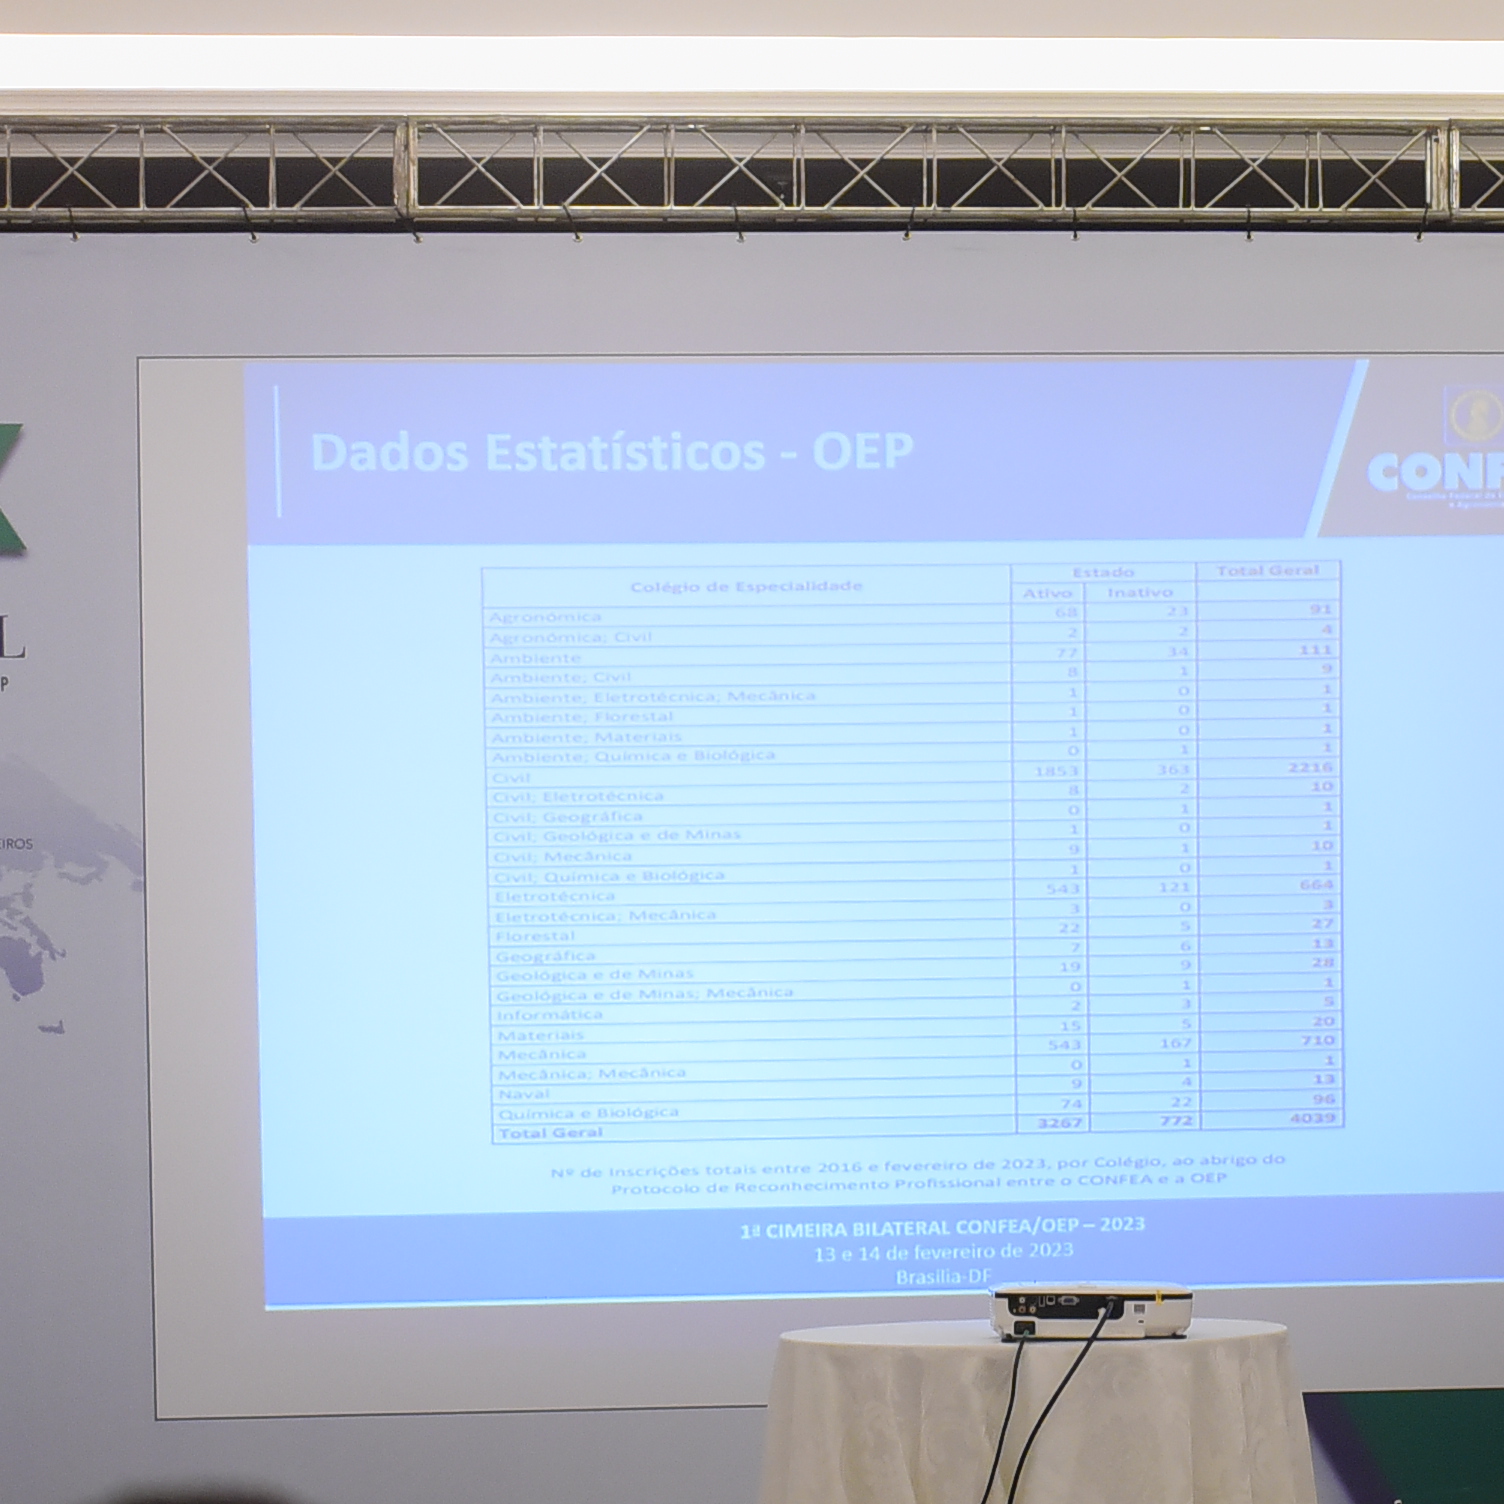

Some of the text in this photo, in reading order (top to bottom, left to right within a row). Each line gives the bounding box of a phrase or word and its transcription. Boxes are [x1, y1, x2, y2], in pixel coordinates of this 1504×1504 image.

[312, 431, 468, 472] Dados
[486, 431, 765, 472] Estatísticos
[813, 431, 915, 470] OEP
[1073, 567, 1134, 578] Estado
[1217, 565, 1319, 577] Total Geral
[630, 579, 864, 595] Colégio de Especialidade
[1023, 588, 1073, 599] Ativo
[1108, 587, 1173, 598] Inativo
[490, 652, 582, 665] Ambiente
[492, 772, 532, 784] Civil
[1159, 882, 1190, 893] 121
[495, 889, 616, 902] Eletrotécnica
[496, 930, 575, 943] Florestal
[496, 950, 596, 964] Geográfica
[496, 967, 694, 984] Geológica e de Minas
[497, 1008, 604, 1021] Informática
[497, 1029, 585, 1041] Materiais
[1301, 1036, 1335, 1046] 710
[1160, 1038, 1192, 1049] 167
[498, 1048, 587, 1062] Mecânica
[498, 1088, 550, 1101] Naval
[499, 1105, 680, 1122] Química e Biológica
[1038, 1118, 1082, 1128] 3267
[1160, 1116, 1193, 1126] 772
[500, 1126, 603, 1140] Total Geral
[551, 1168, 575, 1178] Nº
[581, 1167, 601, 1178] de
[610, 1165, 699, 1178] Inscrições
[706, 1164, 756, 1176] totais
[762, 1164, 810, 1174] entre
[818, 1162, 862, 1173] 2016
[885, 1158, 967, 1172] fevereiro
[974, 1158, 995, 1170] de
[1002, 1158, 1052, 1171] 2023,
[1057, 1158, 1089, 1171] por
[1094, 1156, 1166, 1170] Colégio,
[1172, 1156, 1194, 1166] ao
[1200, 1154, 1257, 1167] abrigo
[1262, 1153, 1285, 1165] do
[611, 1172, 1227, 1195] Protocolo de Reconhecimento Profissional entre o CONFEA e a OEP
[766, 1223, 848, 1239] CIMEIRA
[853, 1222, 950, 1237] BILATERAL
[956, 1217, 1079, 1236] CONFEA/OEP
[1101, 1217, 1146, 1232] 2023
[815, 1242, 1074, 1262] 13 e 14 de fevereiro de 2023
